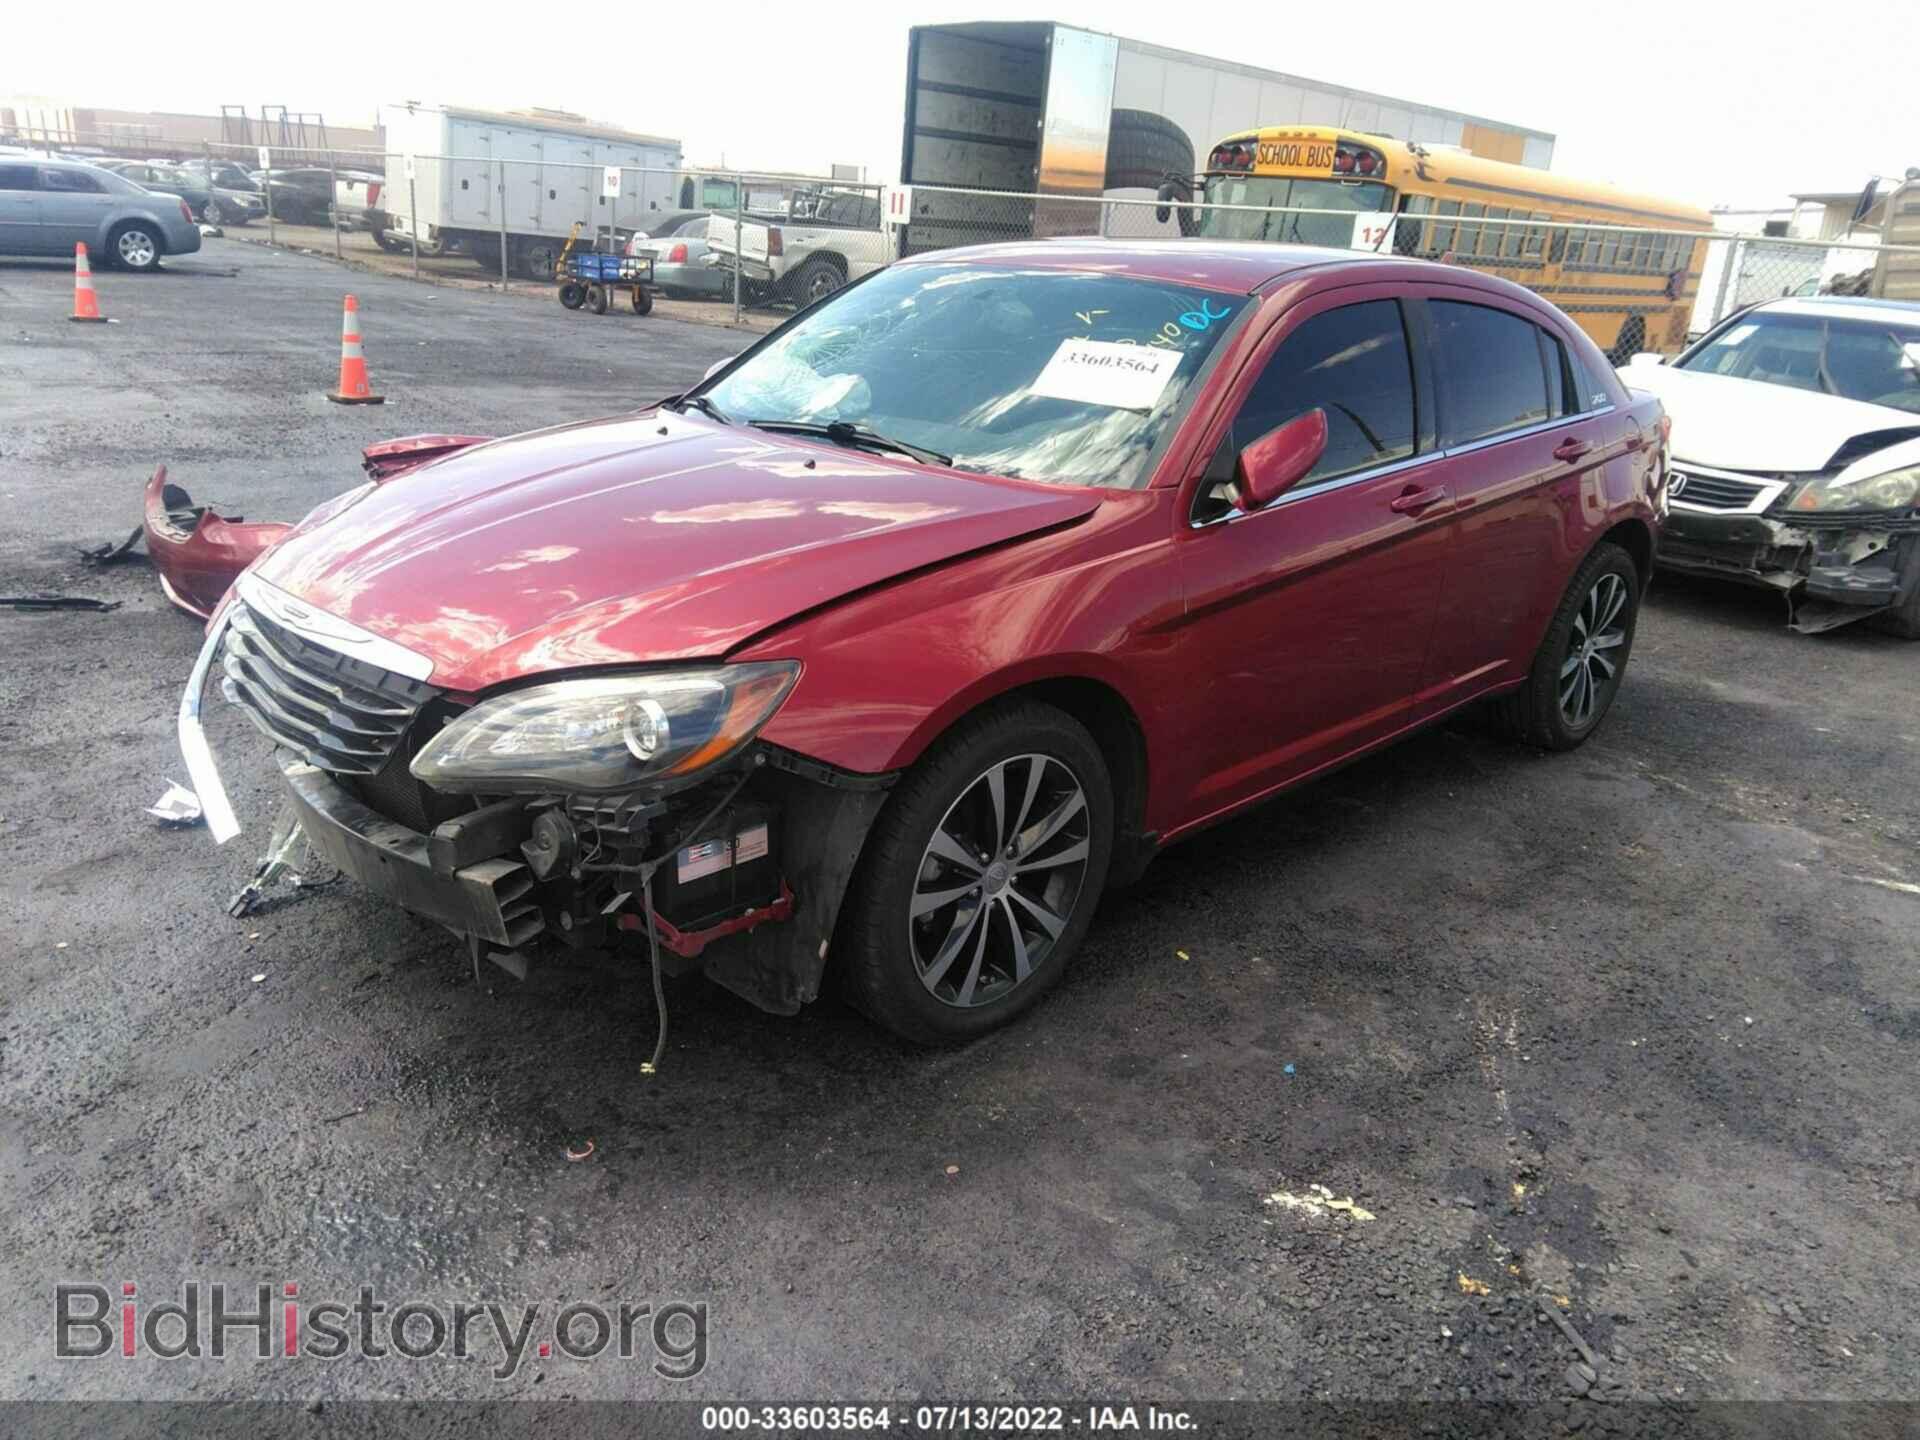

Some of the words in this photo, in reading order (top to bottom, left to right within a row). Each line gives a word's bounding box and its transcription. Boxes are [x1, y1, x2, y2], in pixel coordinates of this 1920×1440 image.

[1257, 143, 1302, 166] SCHOOL
[1306, 145, 1333, 168] BUS
[891, 192, 905, 215] 11
[1362, 226, 1385, 244] 12
[1063, 351, 1160, 375] 33603564
